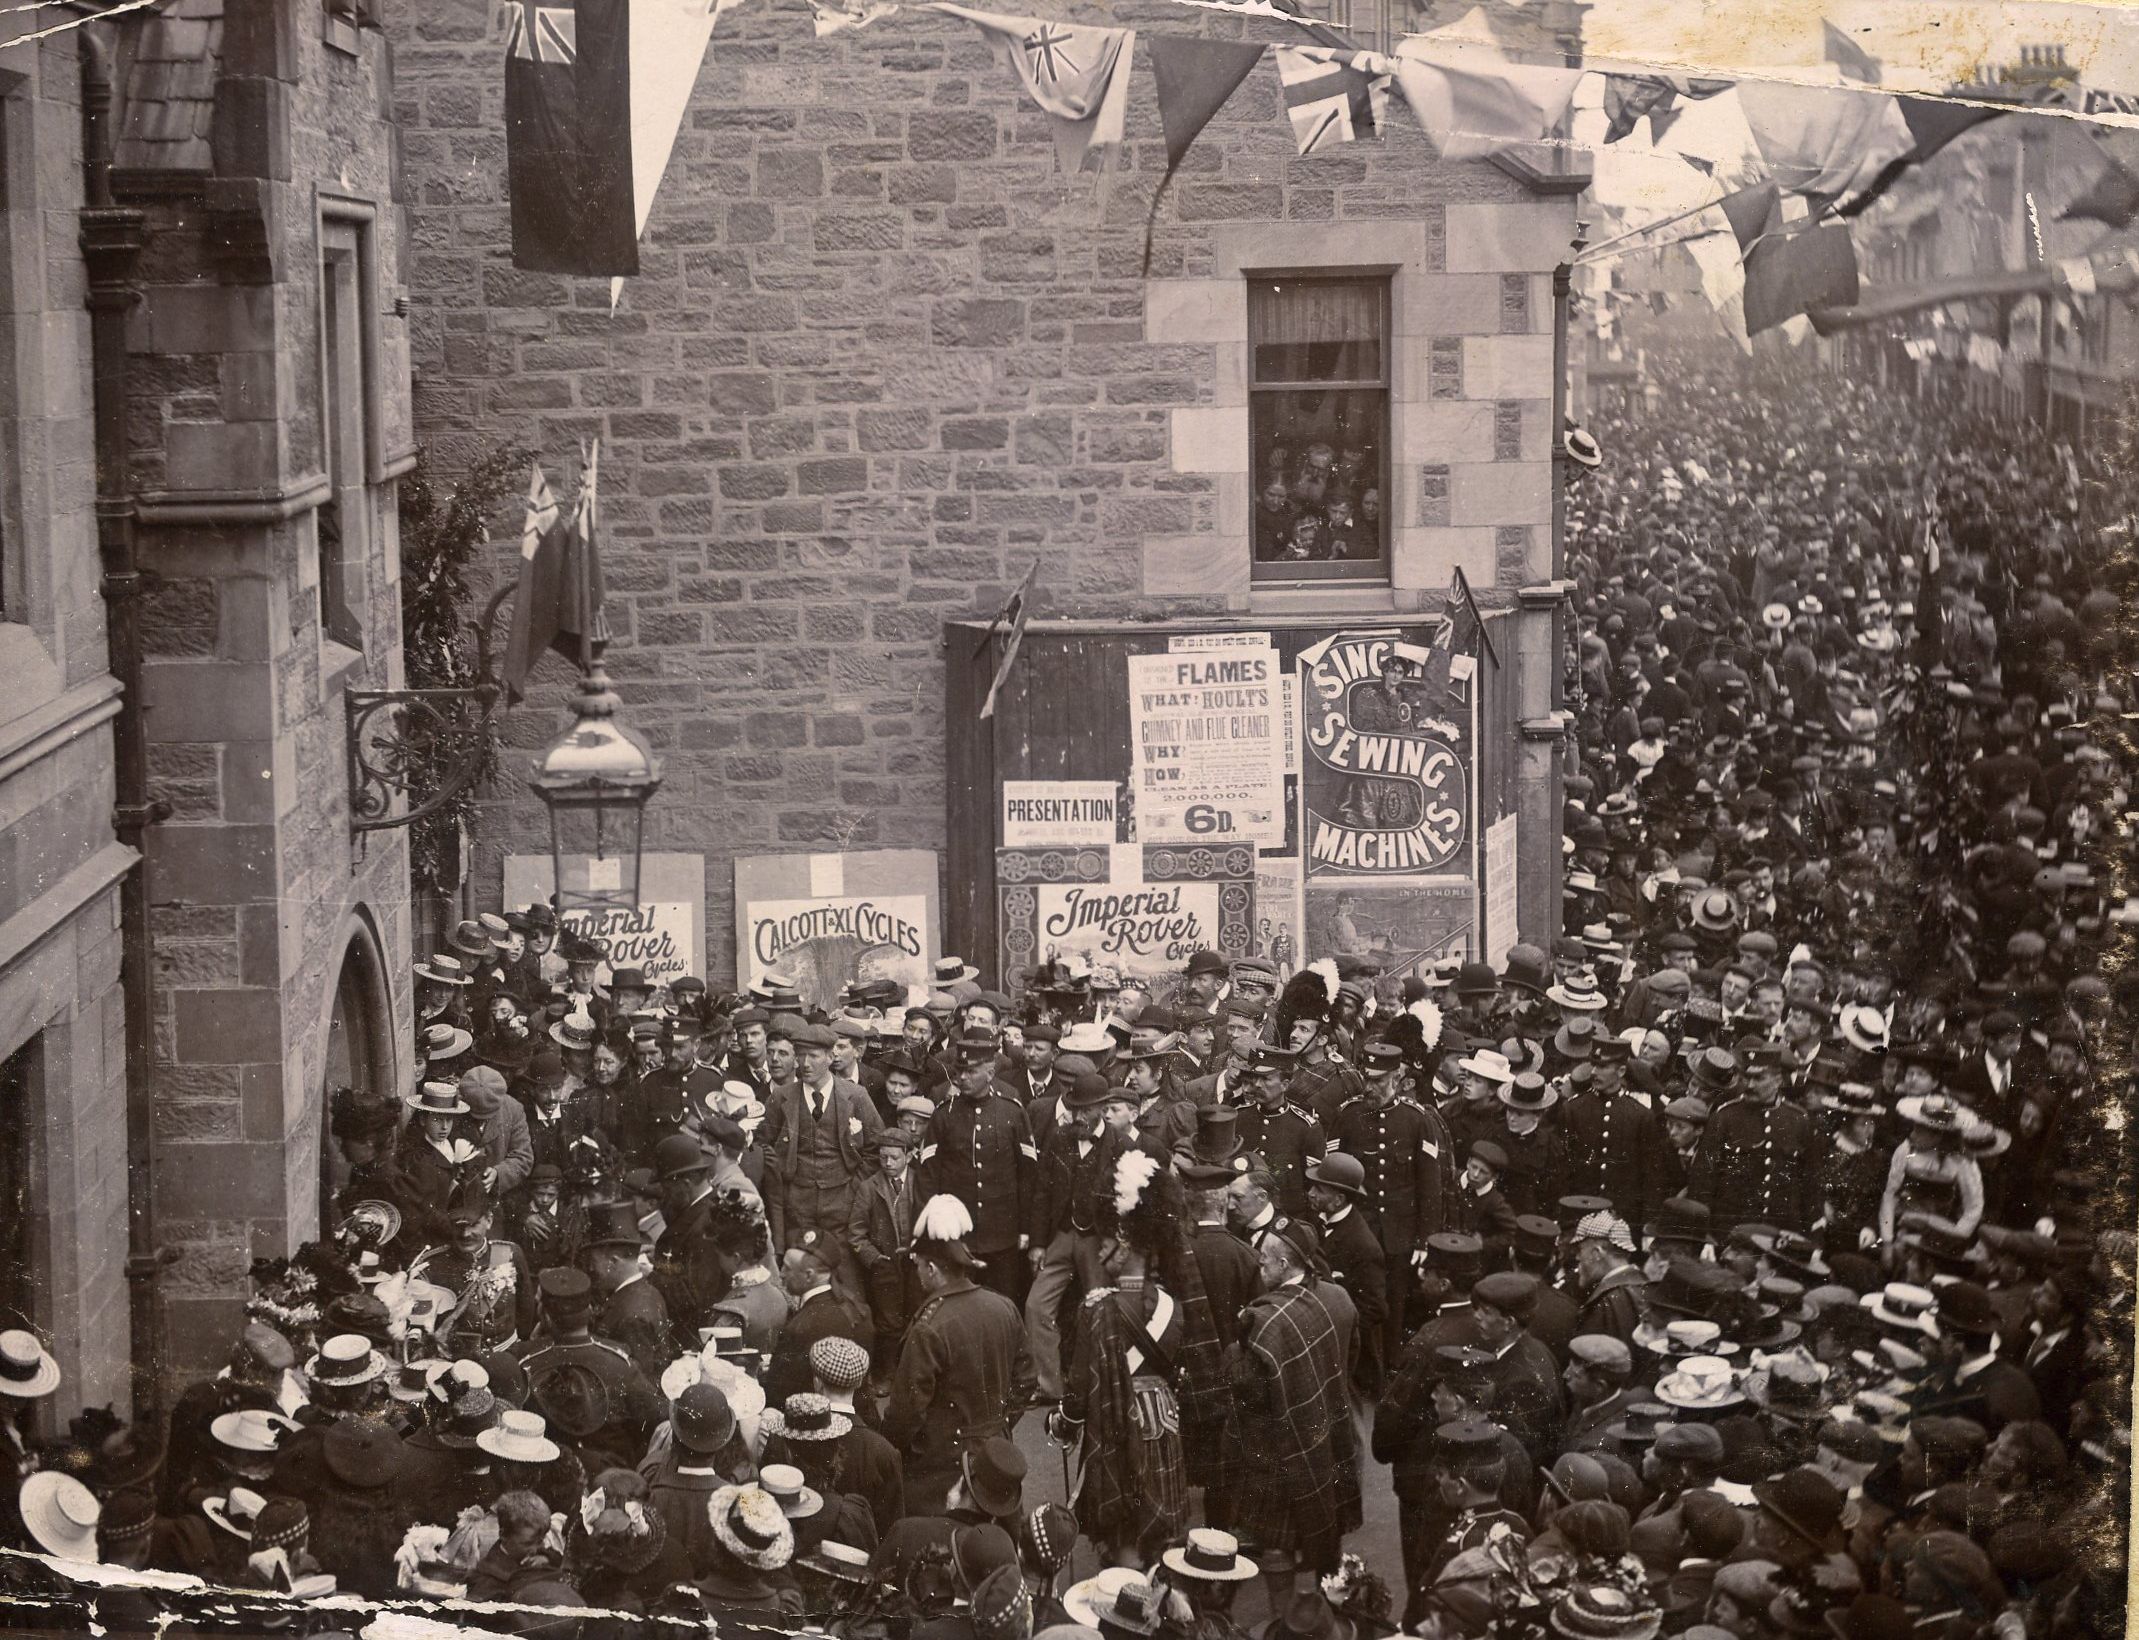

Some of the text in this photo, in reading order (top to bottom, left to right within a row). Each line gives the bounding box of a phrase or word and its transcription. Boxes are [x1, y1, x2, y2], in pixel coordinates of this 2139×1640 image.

[1177, 660, 1268, 685] FLAMES
[1142, 719, 1181, 743] CHIMNEY
[1186, 717, 1203, 741] AND
[1207, 716, 1226, 740] FLUE
[1231, 714, 1270, 739] CLEANER
[1310, 711, 1454, 789] SEWING
[1008, 799, 1113, 822] PRESENTATION
[1311, 801, 1461, 869] MACHINES
[1414, 889, 1433, 897] THE
[1435, 889, 1467, 897] HOME
[562, 905, 656, 938] mperial
[1046, 886, 1181, 937] Imperial
[855, 902, 921, 957] CYCLES
[1101, 911, 1202, 956] Rover
[1165, 940, 1211, 961] Cycles
[641, 959, 685, 979] Cycles
